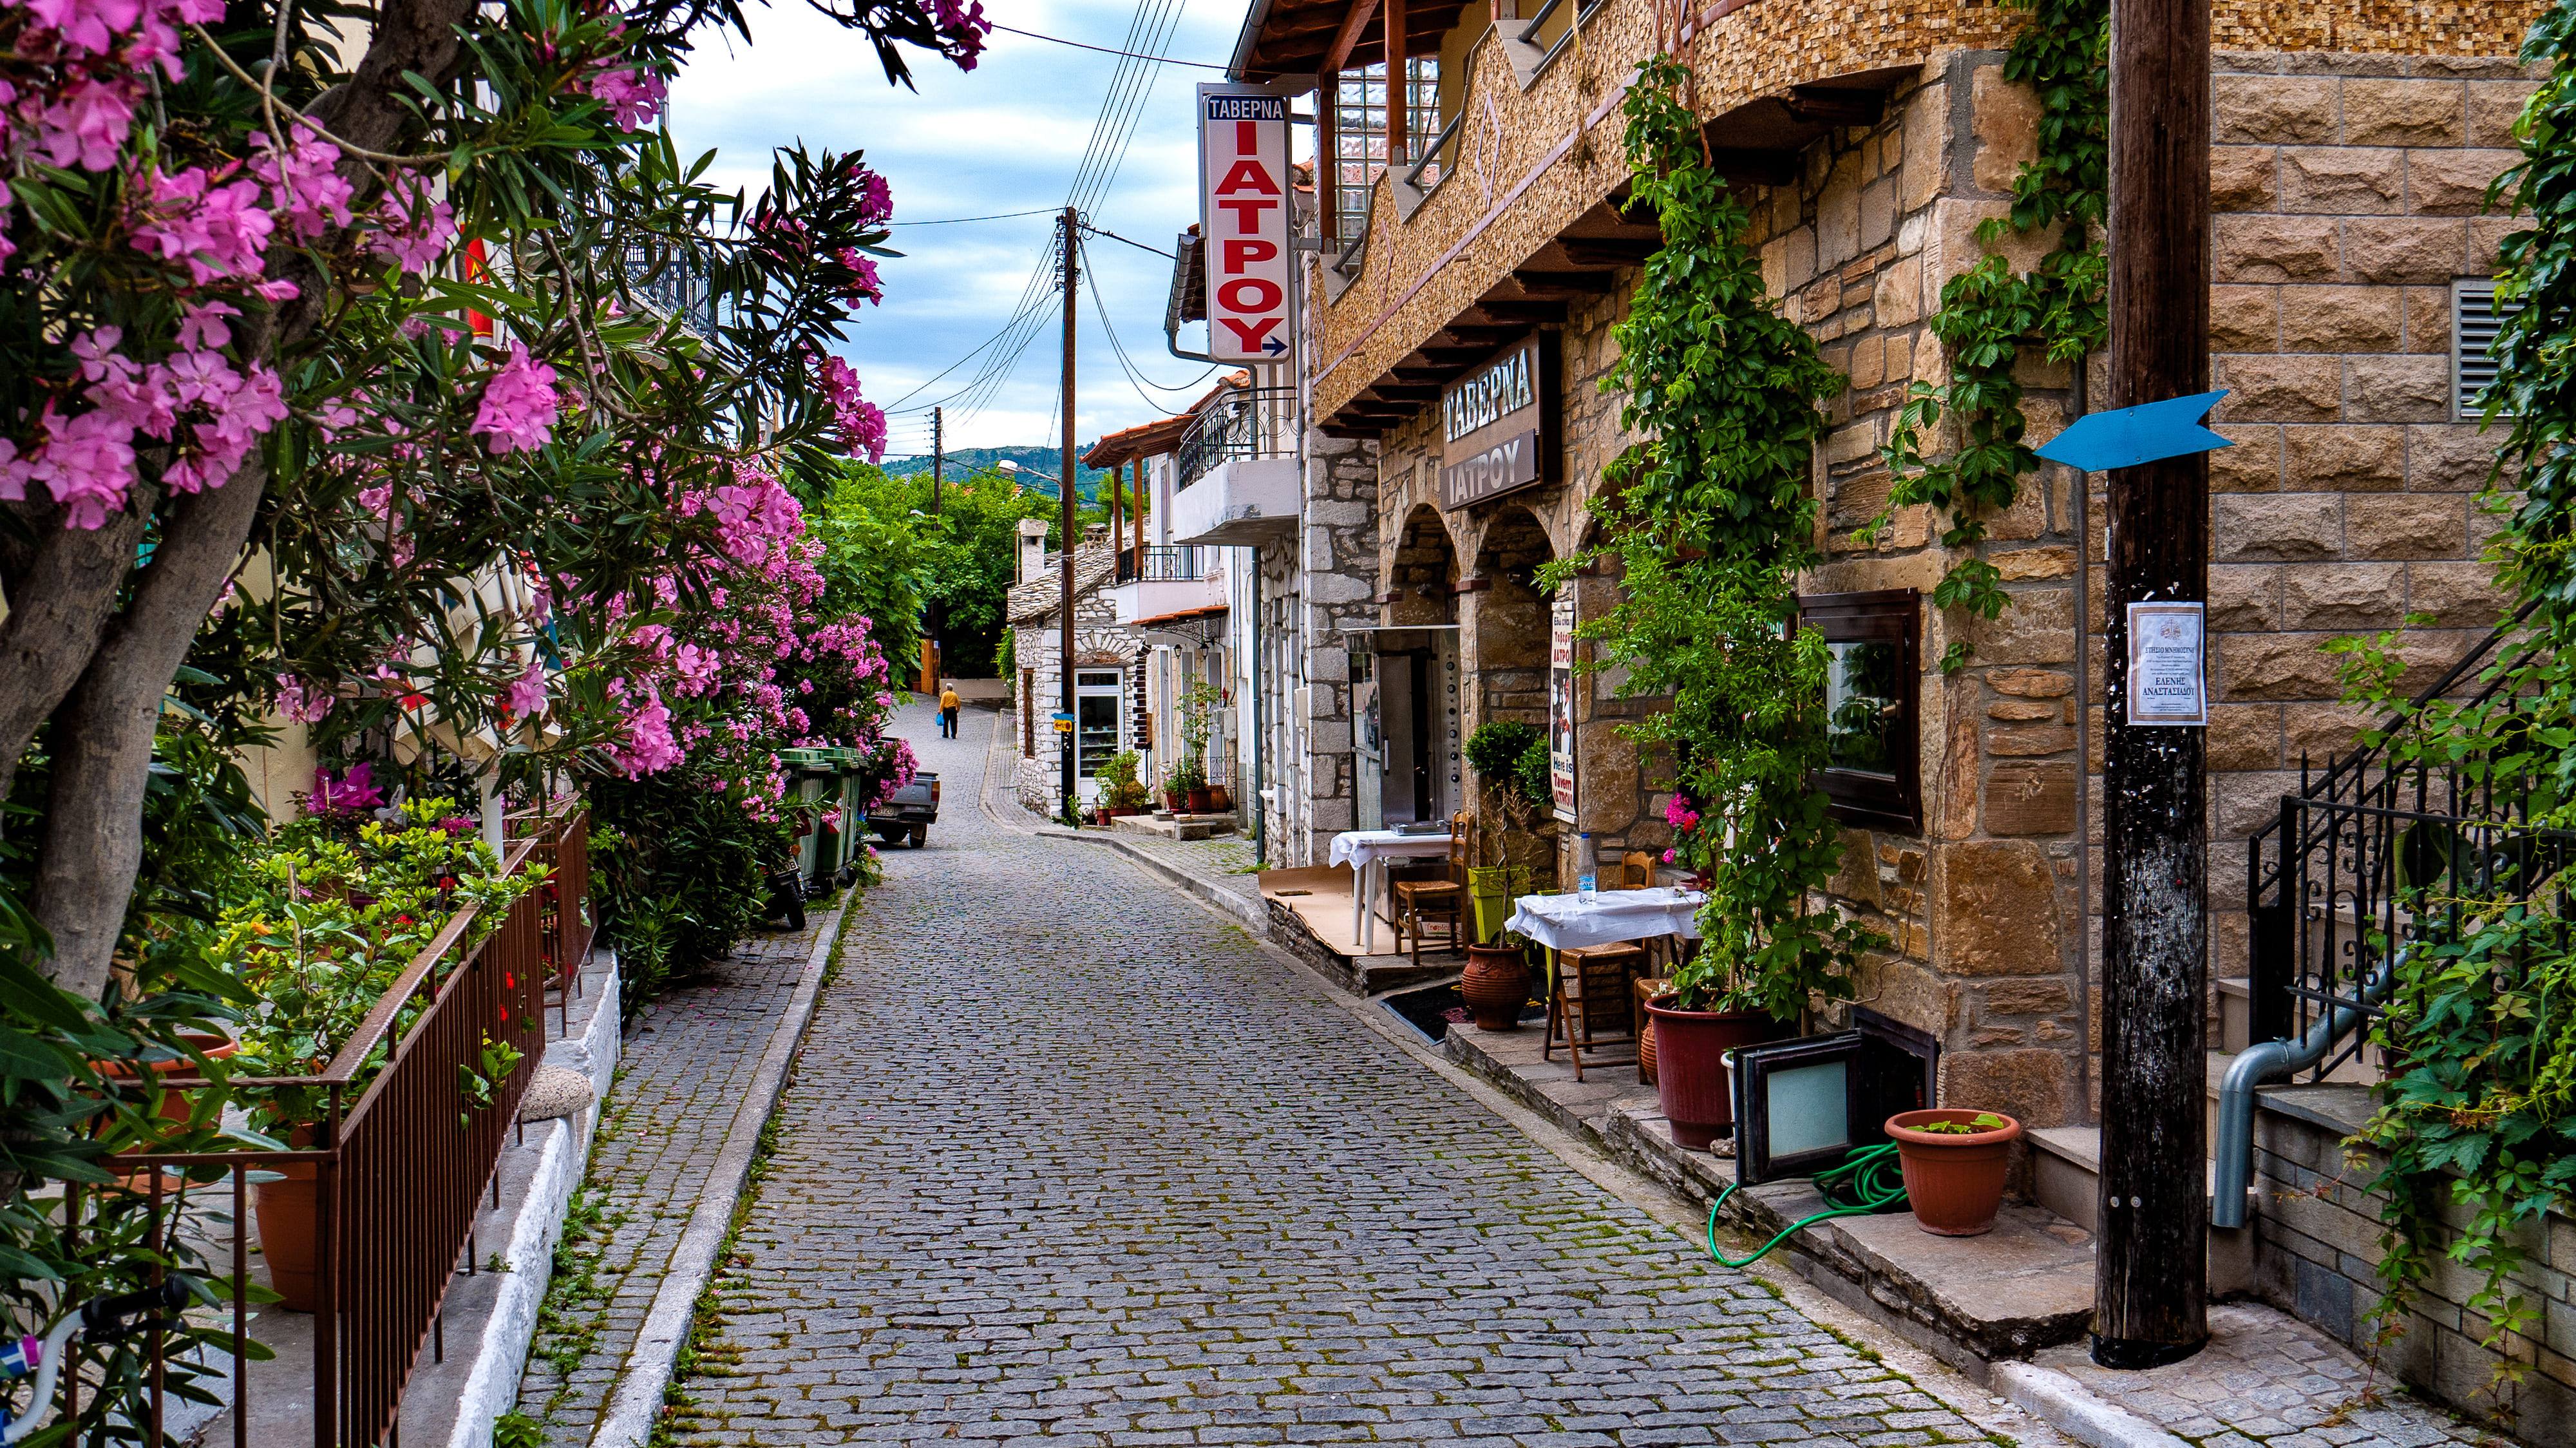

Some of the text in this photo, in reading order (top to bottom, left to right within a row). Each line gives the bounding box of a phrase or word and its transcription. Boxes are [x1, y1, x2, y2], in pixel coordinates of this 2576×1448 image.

[1209, 100, 1283, 119] ΤΑΒΕΡΝΑ
[1214, 120, 1285, 353] ΙΑΤΡΟΥ
[1443, 348, 1533, 443] ΤΑΒΕΡΝΑ
[1449, 439, 1520, 505] ΙΑΤΡΟΥ
[1554, 649, 1571, 663] ΙΑΤΡΟ
[2155, 677, 2185, 685] ΕΛΕΝΗΣ
[1553, 756, 1573, 773] Here is
[1553, 773, 1572, 791] Tavern
